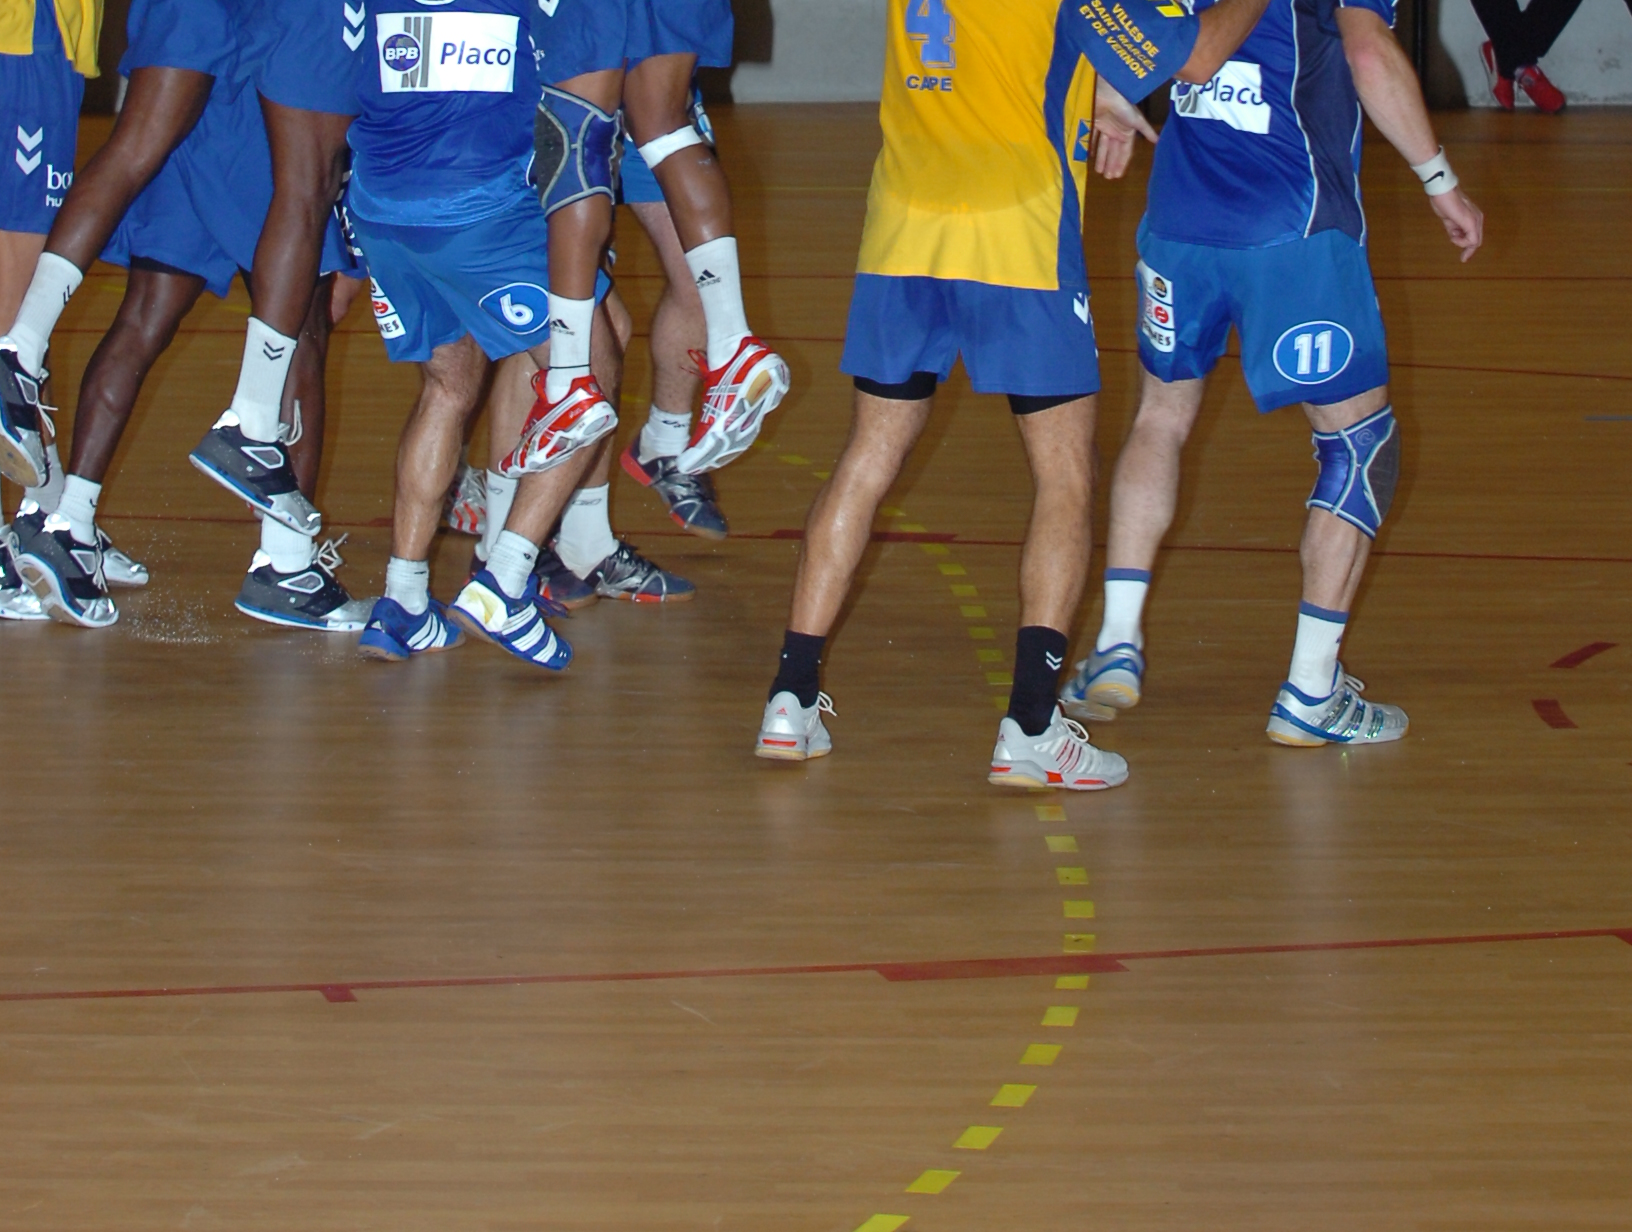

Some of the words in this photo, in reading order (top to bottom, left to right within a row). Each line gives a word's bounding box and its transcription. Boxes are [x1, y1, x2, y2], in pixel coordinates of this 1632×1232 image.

[1079, 4, 1096, 20] ET
[1091, 20, 1108, 36] DE
[1106, 35, 1148, 80] VERNON
[1112, 3, 1144, 43] VILLES
[1141, 40, 1160, 58] DE
[385, 46, 420, 60] BPB
[440, 40, 512, 66] Placo
[1117, 33, 1157, 72] MARCEL
[905, 75, 953, 92] CAPE
[500, 293, 534, 326] 6
[1294, 330, 1332, 375] 11
